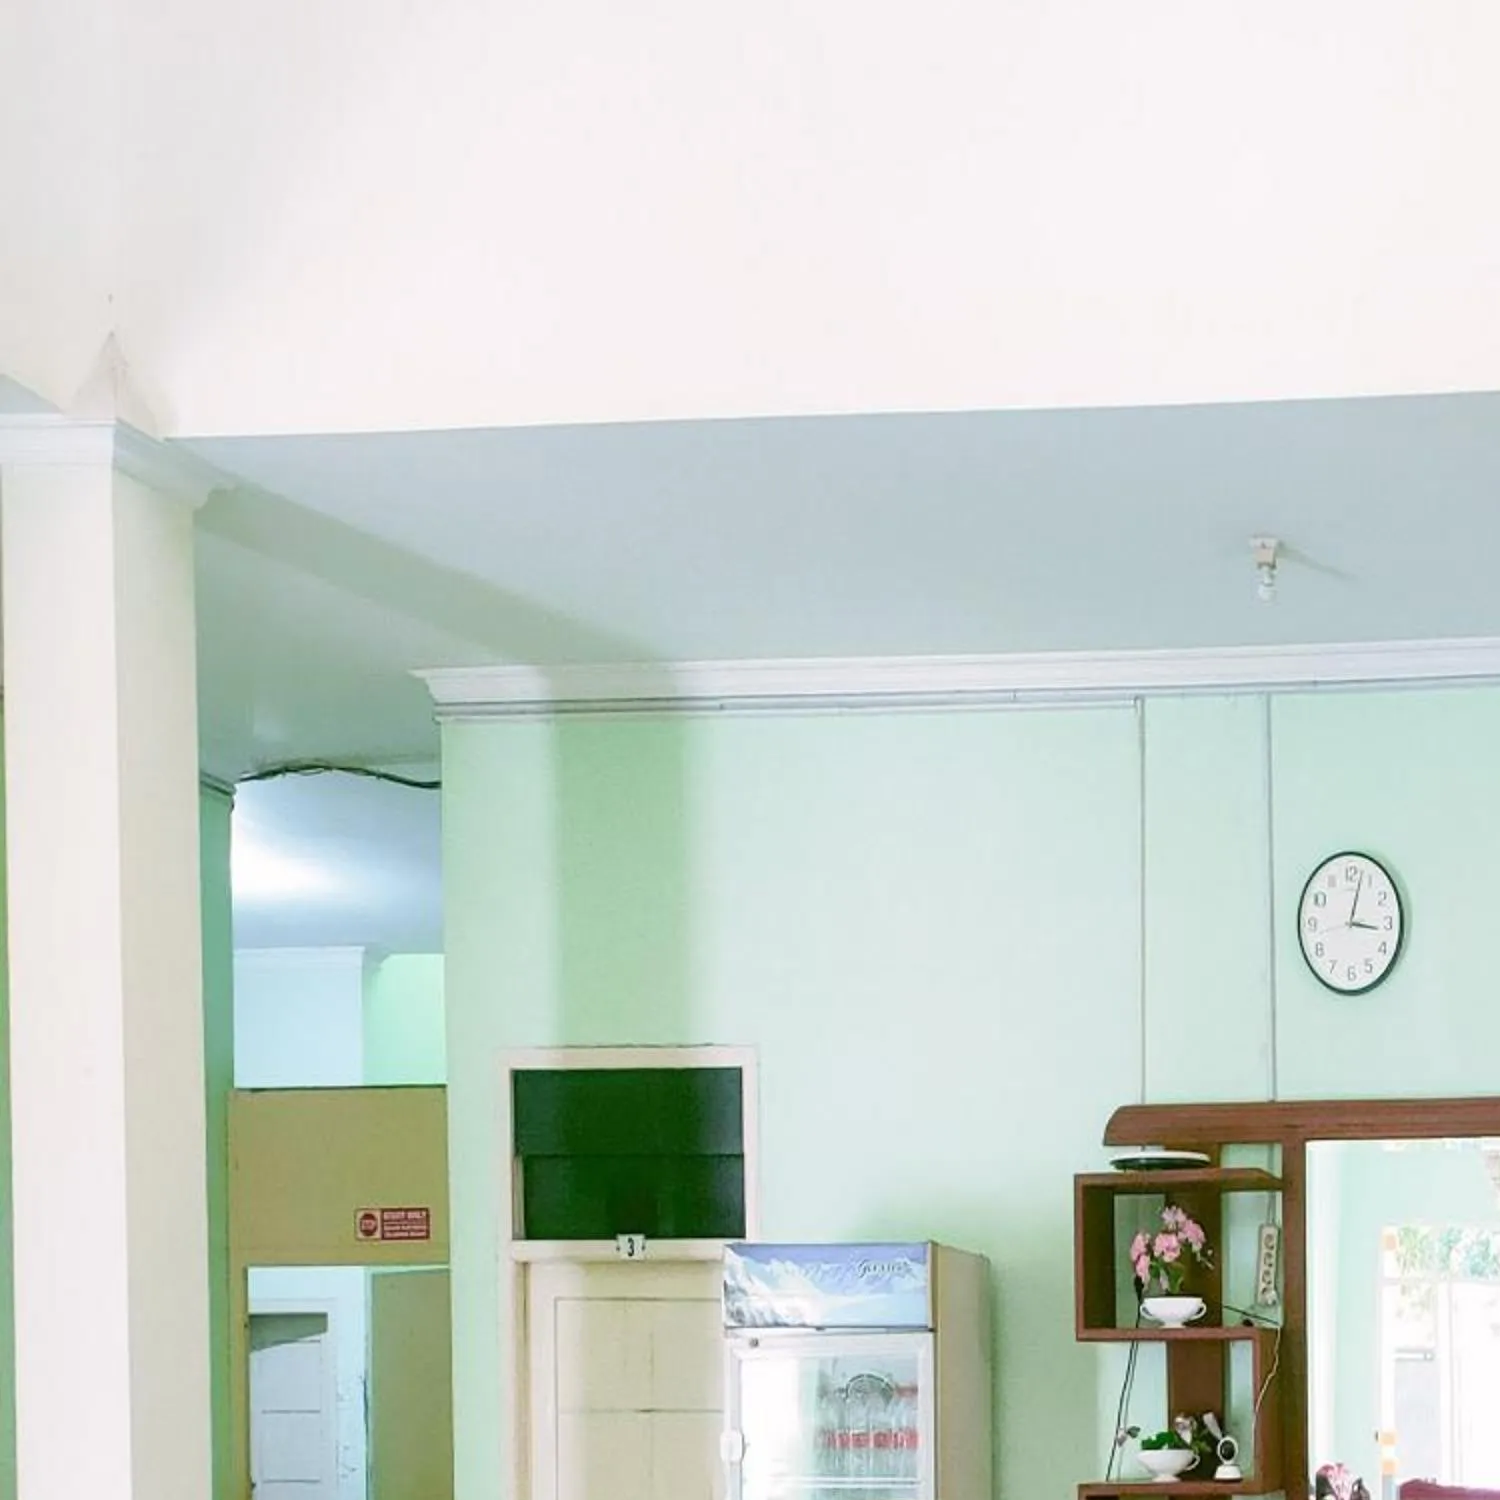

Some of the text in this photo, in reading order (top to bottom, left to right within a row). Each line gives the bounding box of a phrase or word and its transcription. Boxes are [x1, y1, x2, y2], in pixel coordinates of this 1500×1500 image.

[1345, 865, 1357, 882] 12
[1378, 891, 1387, 907] 2
[1307, 916, 1318, 932] 9
[1383, 915, 1393, 931] 3
[1315, 942, 1325, 957] 8
[1378, 941, 1387, 955] 4
[1328, 959, 1338, 974] 7
[1347, 966, 1357, 981] 6
[1364, 960, 1373, 974] 5
[627, 1237, 635, 1257] 3
